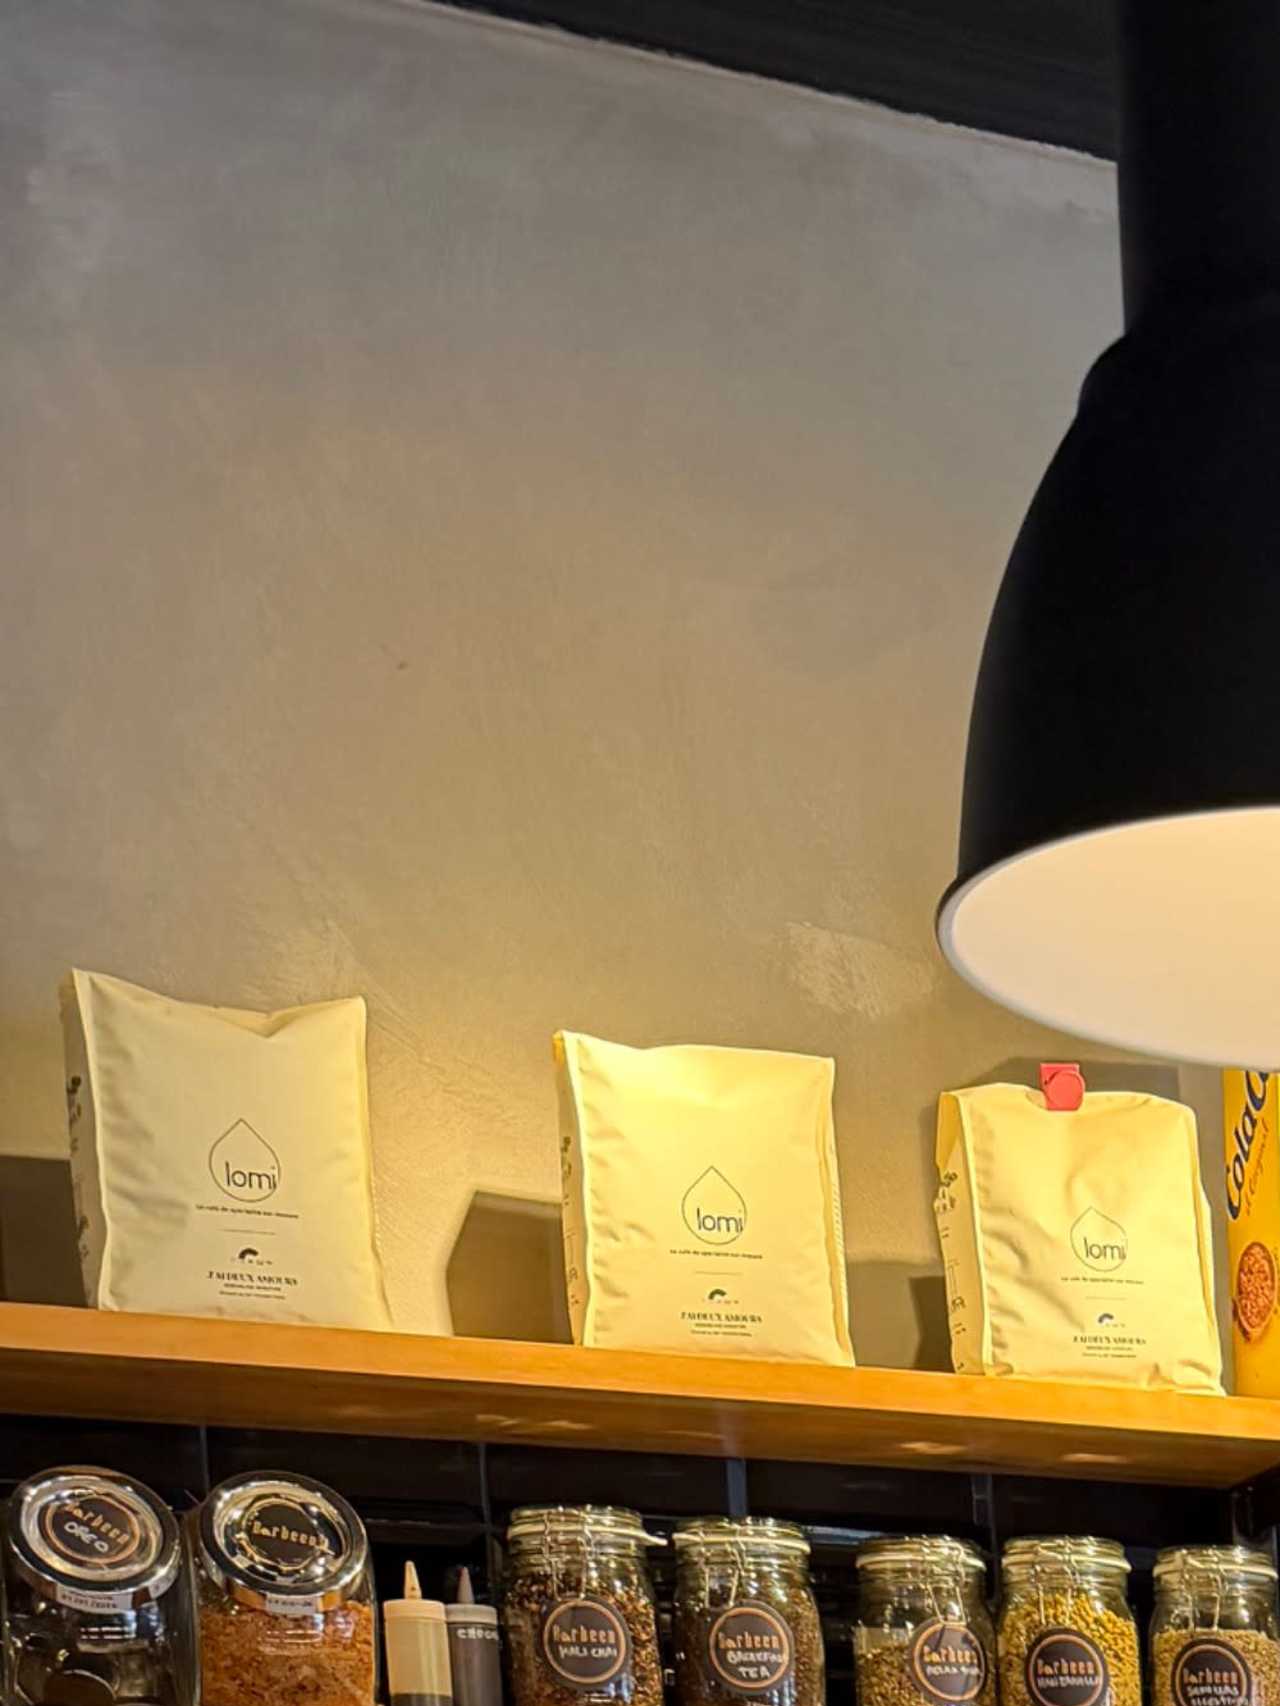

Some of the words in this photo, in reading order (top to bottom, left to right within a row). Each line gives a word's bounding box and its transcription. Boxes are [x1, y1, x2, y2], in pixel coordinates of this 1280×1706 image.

[225, 1161, 277, 1190] lomi
[696, 1207, 743, 1233] lomi
[1083, 1236, 1126, 1260] lomi
[552, 1625, 616, 1644] Barbeen
[718, 1631, 780, 1649] Barbeen
[738, 1666, 770, 1679] TEA
[1037, 1658, 1095, 1676] Barbeen
[1182, 1667, 1238, 1685] Barbeen
